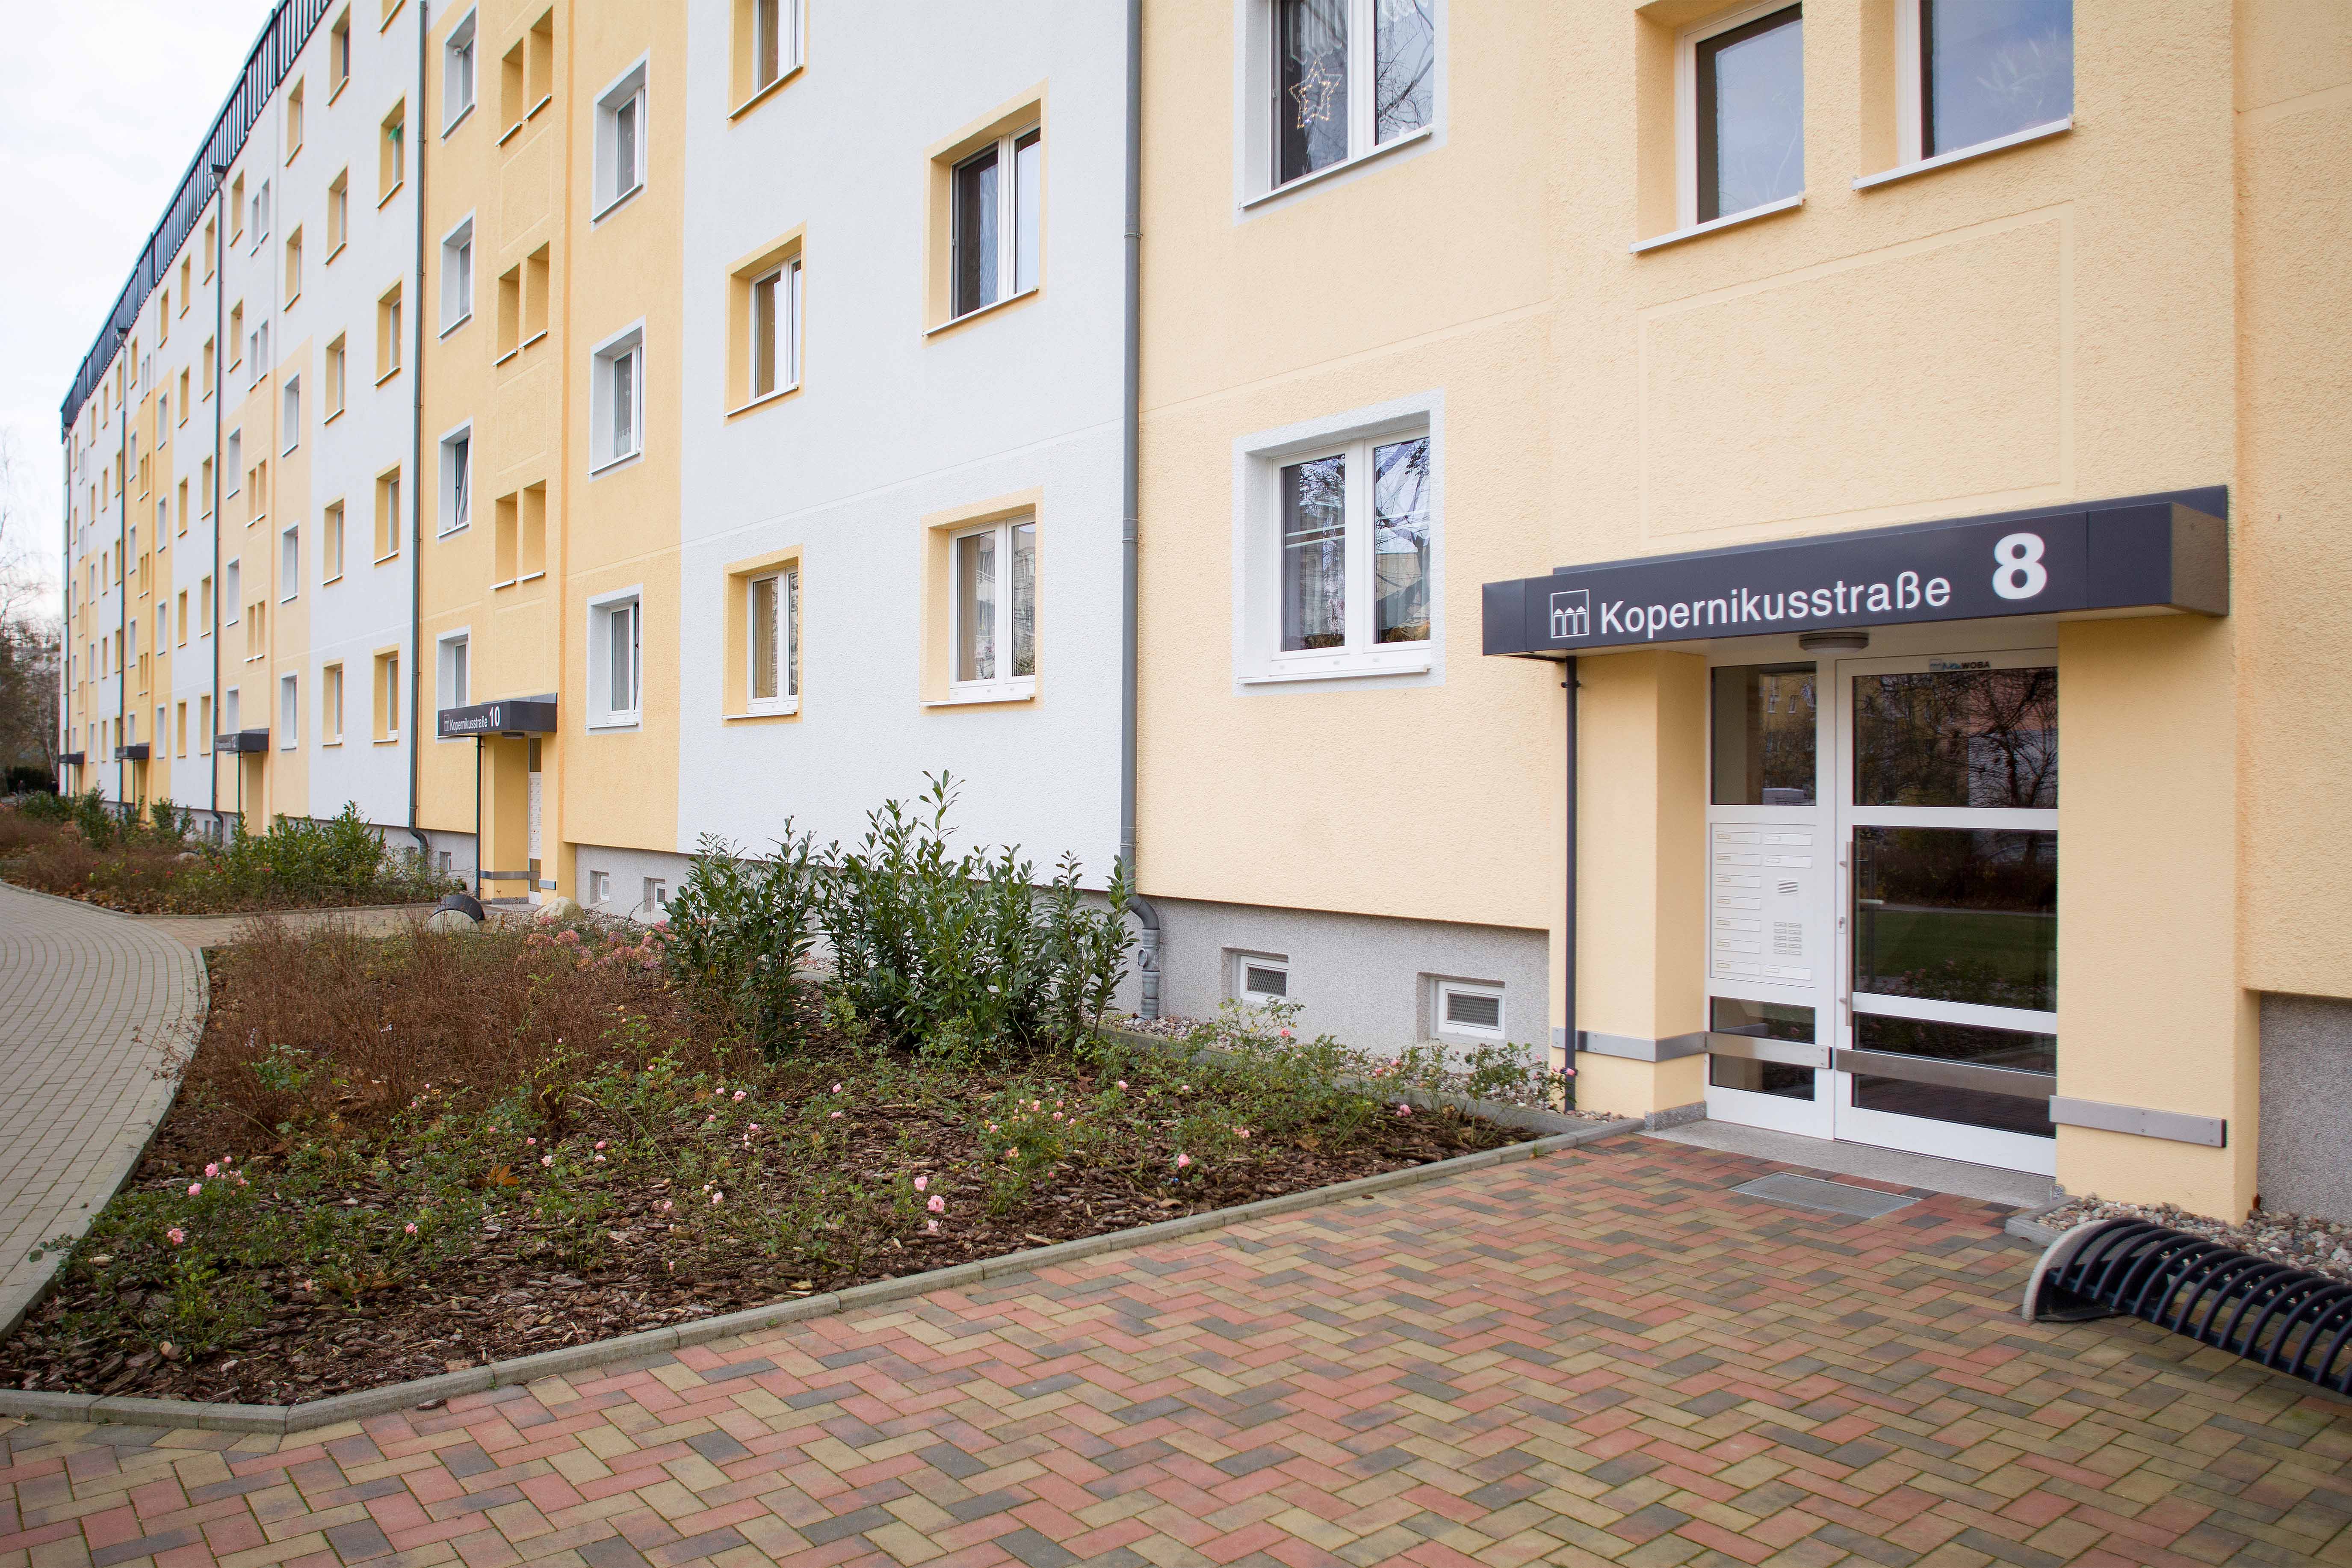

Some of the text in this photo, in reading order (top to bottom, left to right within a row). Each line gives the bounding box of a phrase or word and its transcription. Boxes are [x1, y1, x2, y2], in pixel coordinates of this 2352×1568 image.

[1601, 533, 2047, 638] Kopernikusstraße 8
[450, 706, 500, 732] Kopernikusstraße 10
